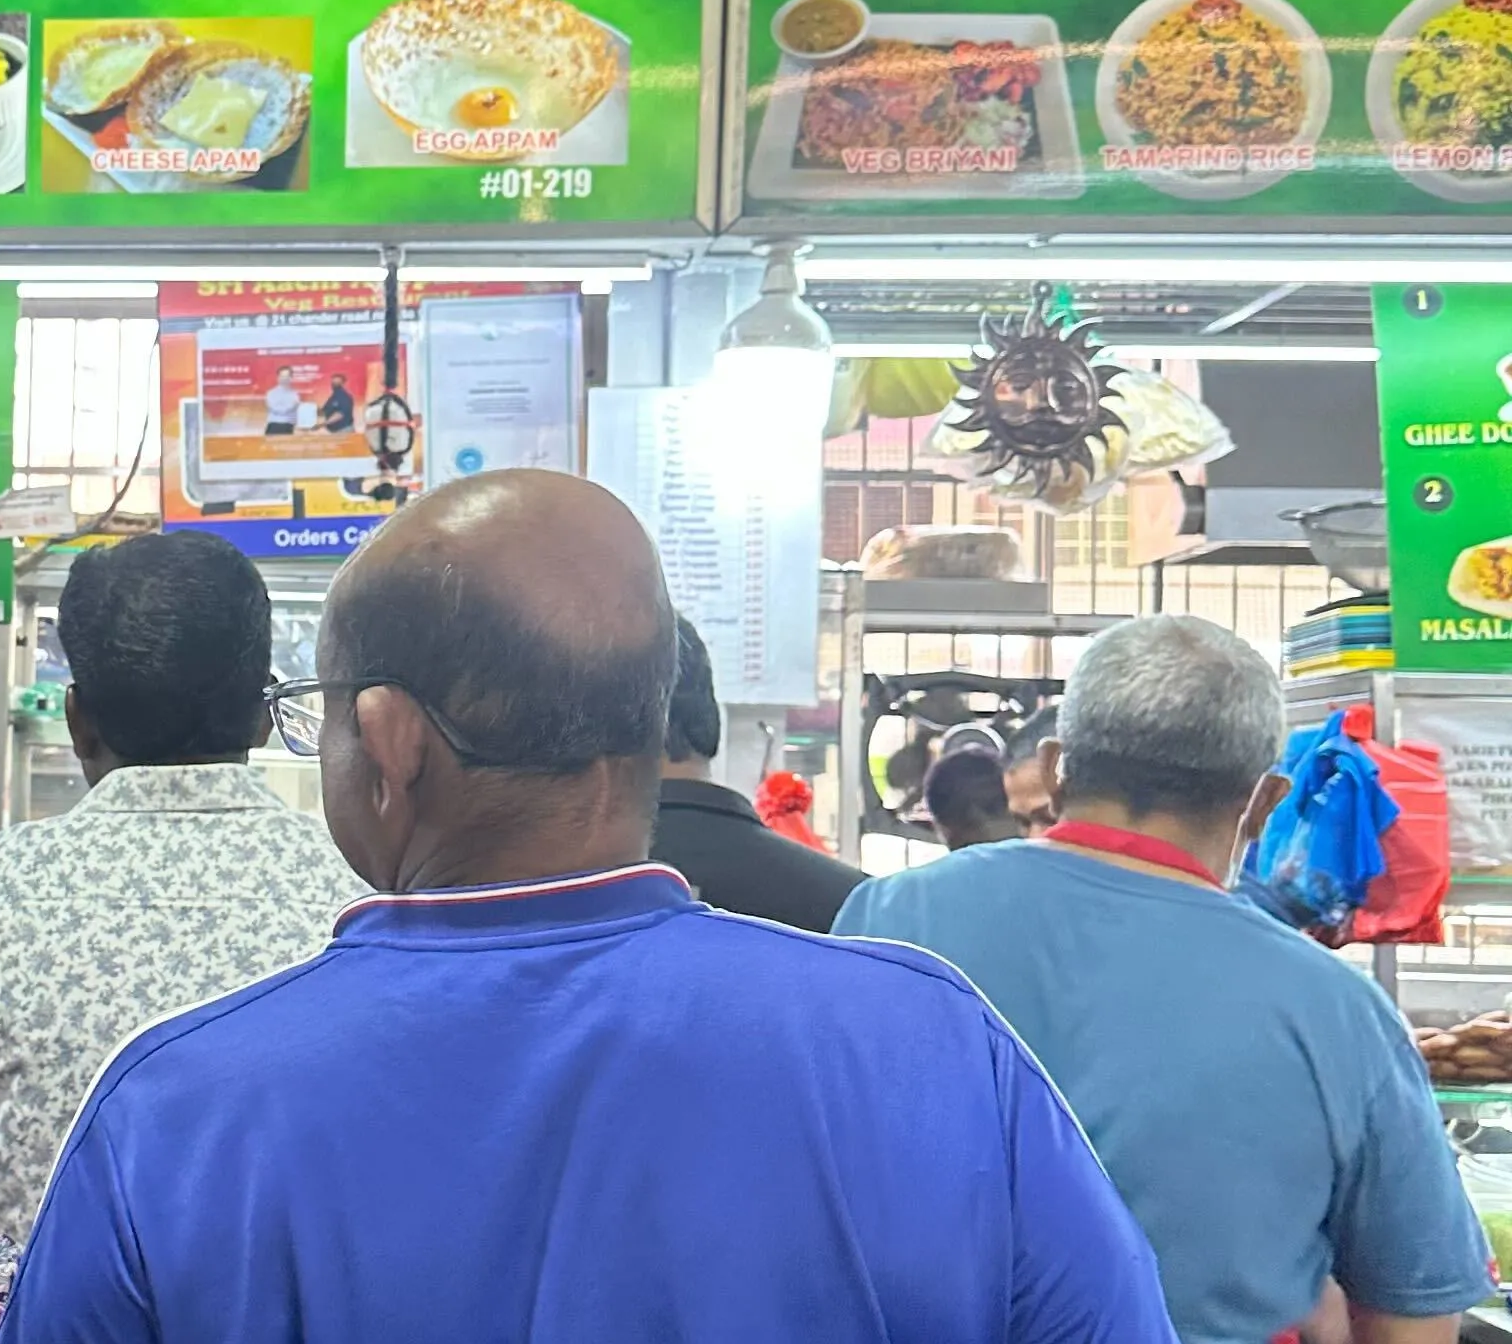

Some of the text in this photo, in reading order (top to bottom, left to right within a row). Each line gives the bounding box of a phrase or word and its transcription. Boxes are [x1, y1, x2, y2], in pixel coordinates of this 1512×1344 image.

[415, 130, 558, 151] EGG APPAM
[91, 150, 259, 171] CHEESE APAM
[842, 147, 1016, 172] VEG BRIYANI
[1103, 147, 1315, 169] TAMARIND RICE
[1392, 146, 1494, 169] LEMON
[479, 168, 592, 199] #01-219
[1416, 289, 1428, 311] 1
[1405, 422, 1475, 446] GHEE
[1423, 479, 1443, 503] 2
[274, 528, 339, 547] Orders
[1420, 618, 1512, 642] MASAL
